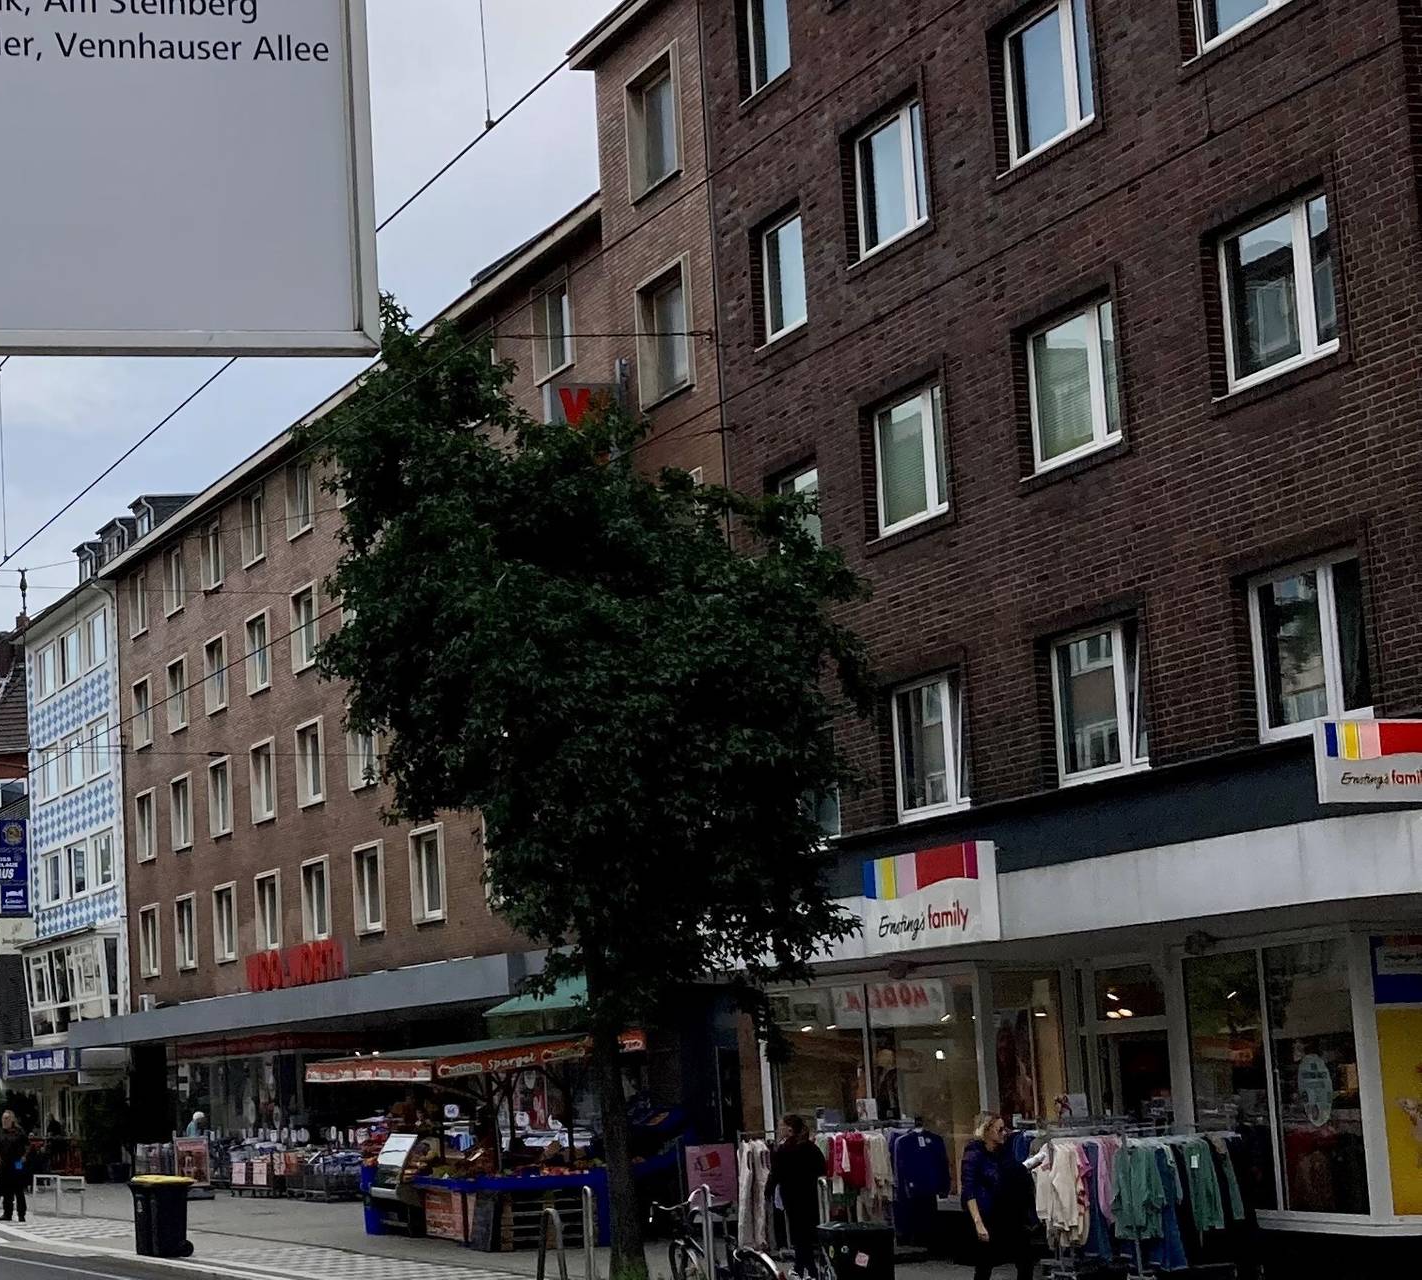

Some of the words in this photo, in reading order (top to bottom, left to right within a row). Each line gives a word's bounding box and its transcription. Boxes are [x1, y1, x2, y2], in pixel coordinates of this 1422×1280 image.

[55, 31, 242, 61] Vennhauser
[253, 34, 330, 62] Allee
[878, 912, 926, 941] Ernsting's
[928, 899, 970, 932] family
